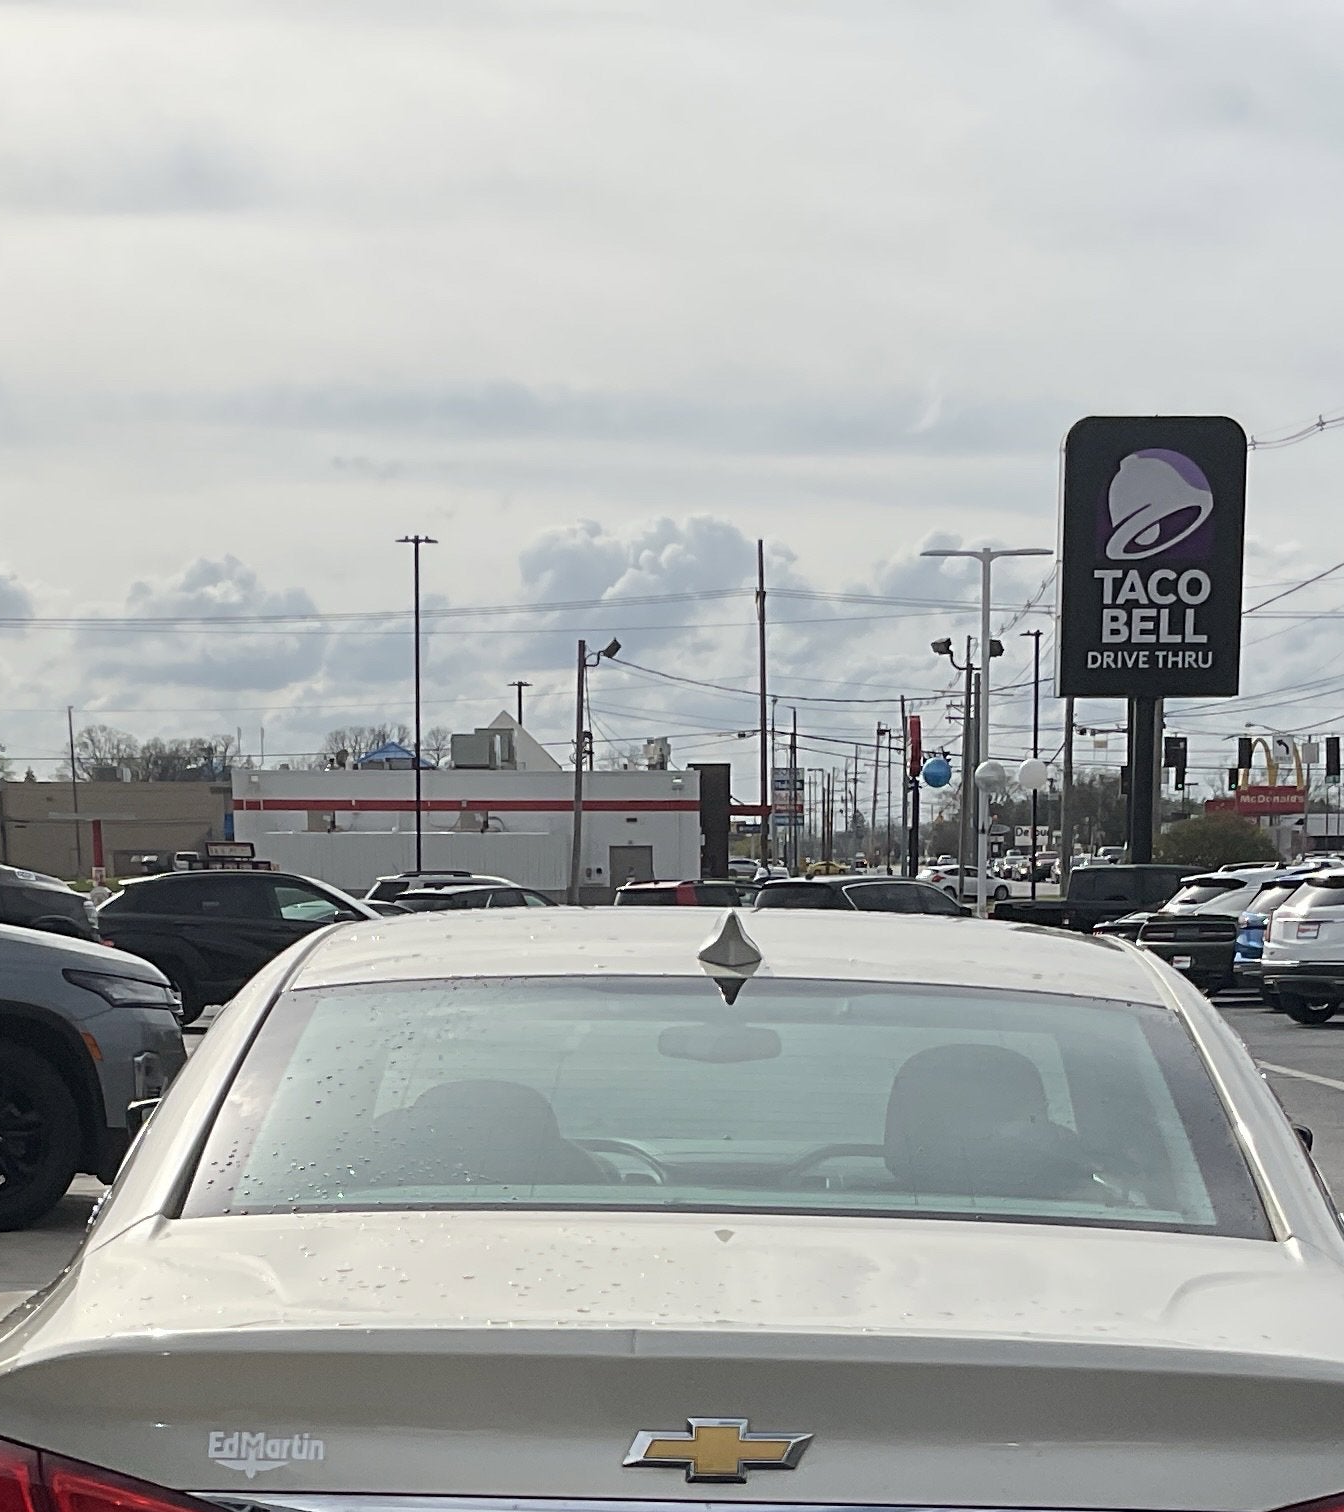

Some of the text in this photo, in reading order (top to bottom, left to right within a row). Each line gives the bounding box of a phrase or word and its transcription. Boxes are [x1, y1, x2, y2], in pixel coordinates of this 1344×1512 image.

[1093, 568, 1212, 605] TACO
[1101, 608, 1208, 643] BELL
[1087, 651, 1213, 669] DRIVE THRU
[208, 1431, 324, 1463] EdMartin
